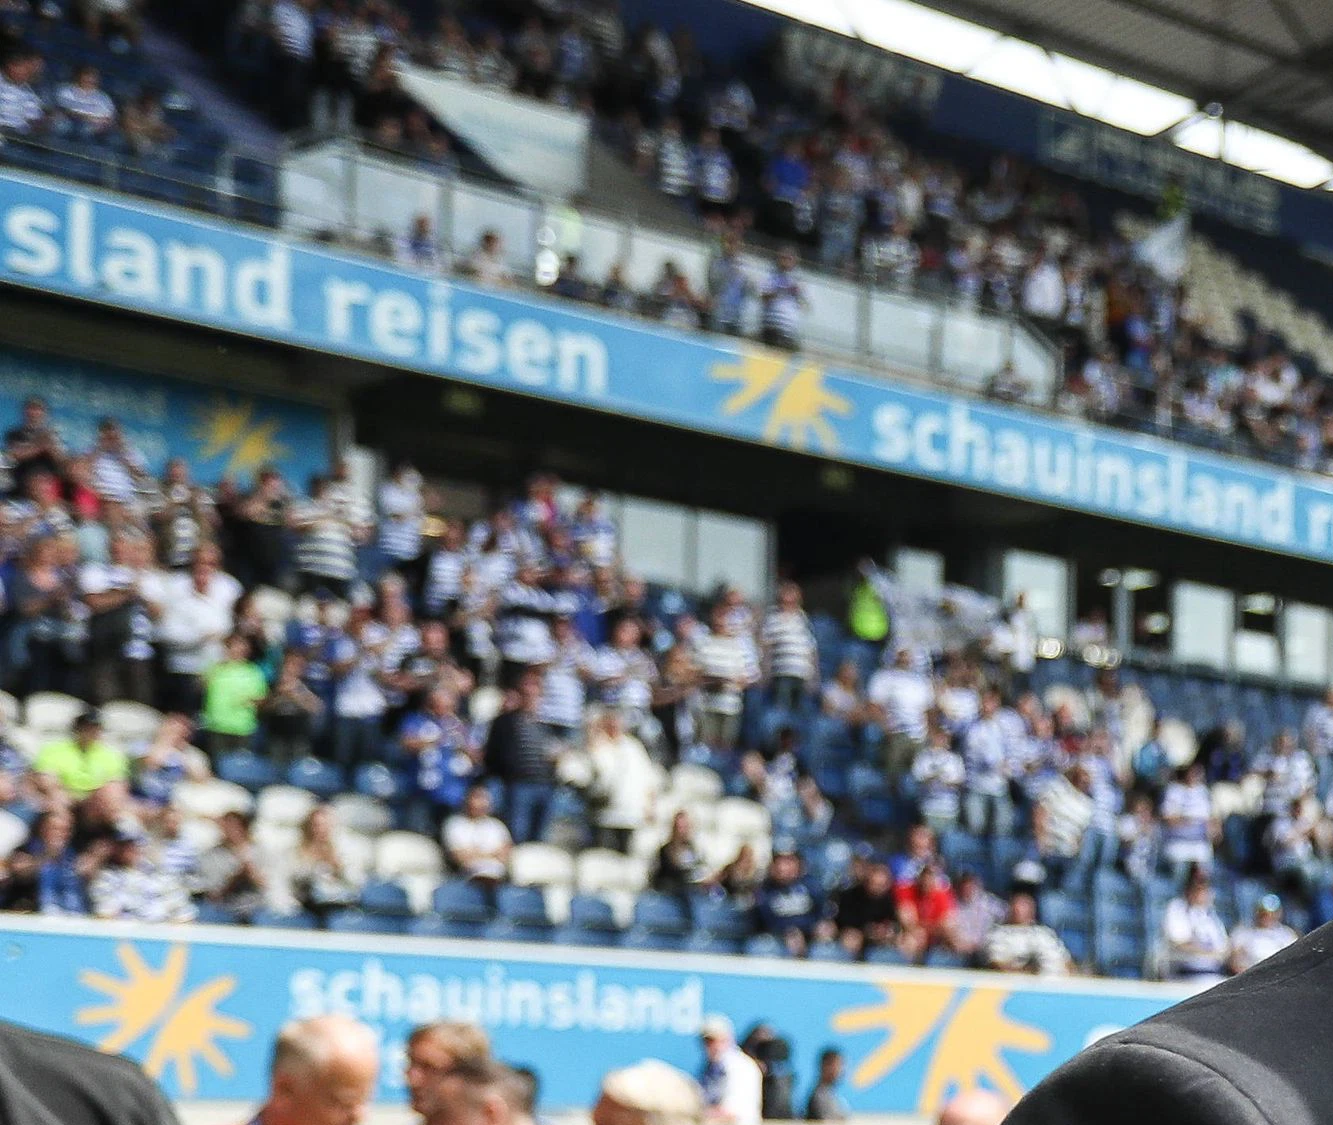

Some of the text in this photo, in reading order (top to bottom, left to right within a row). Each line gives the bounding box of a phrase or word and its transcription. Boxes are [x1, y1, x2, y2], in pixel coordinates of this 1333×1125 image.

[3, 197, 610, 396] sland reisen
[872, 398, 1294, 545] schauinsland
[289, 957, 703, 1036] schauinsland
